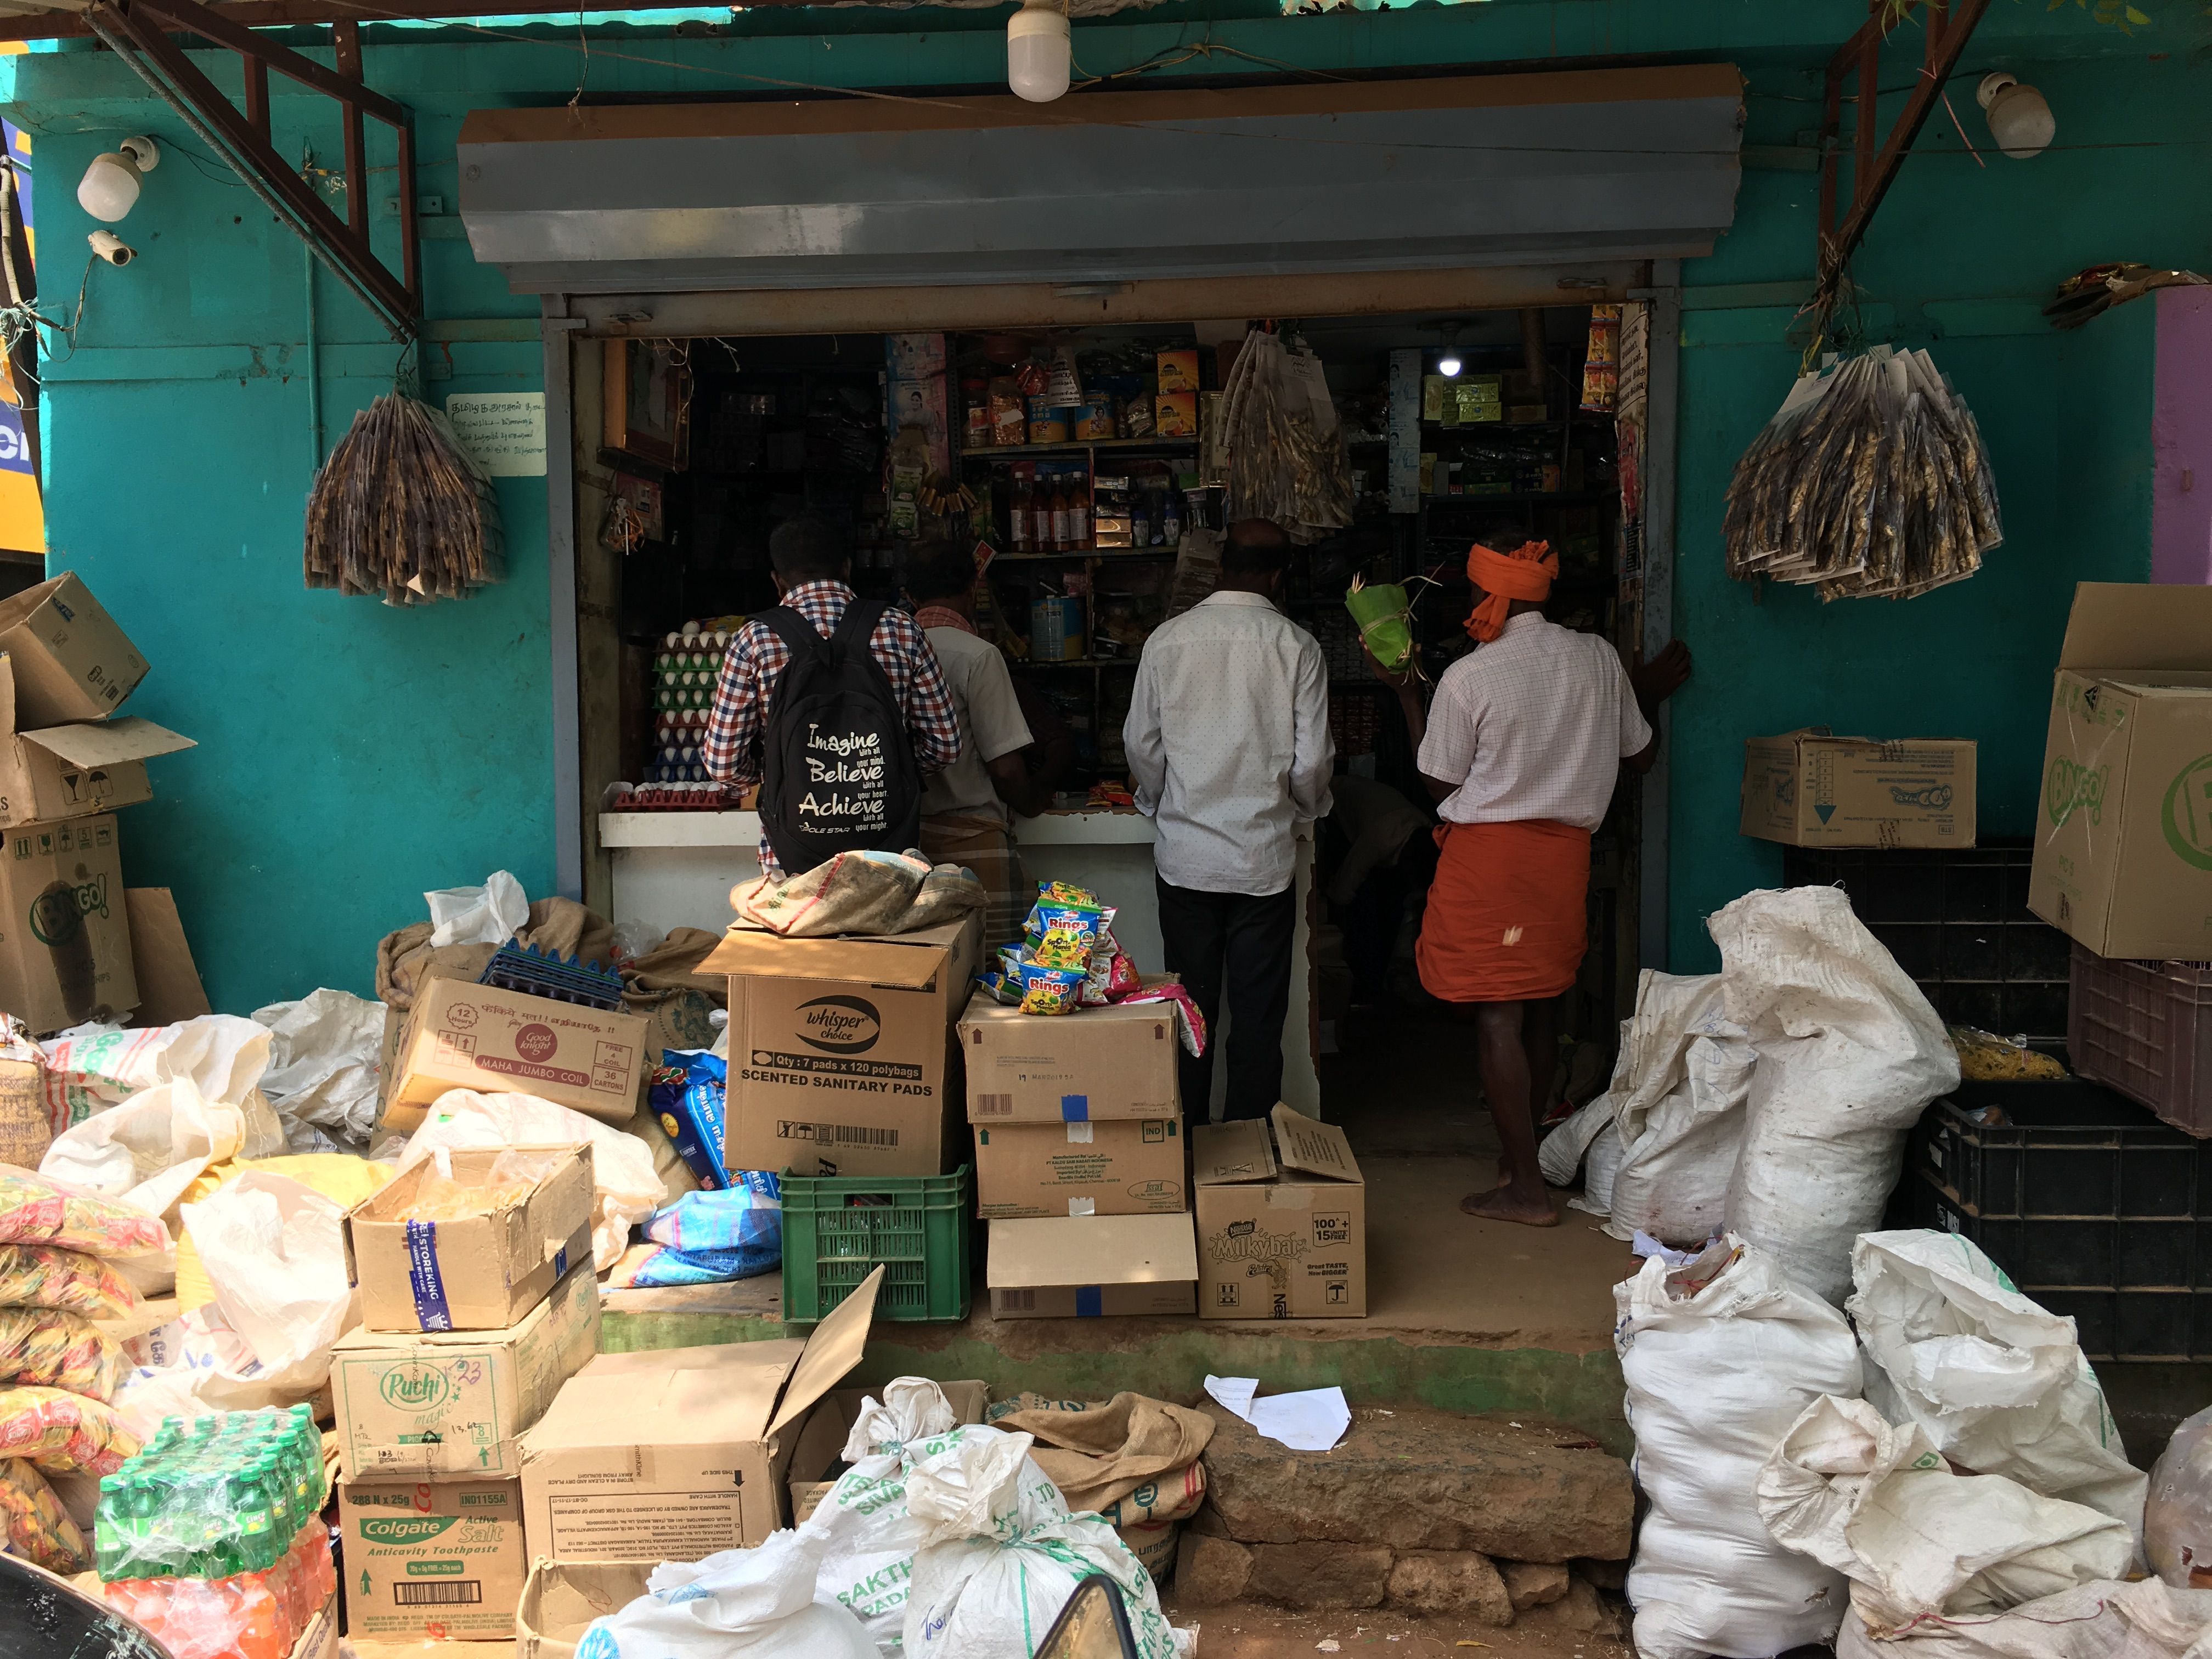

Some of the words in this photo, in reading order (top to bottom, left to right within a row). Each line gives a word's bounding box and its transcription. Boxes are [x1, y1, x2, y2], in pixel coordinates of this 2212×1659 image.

[808, 724, 879, 756] Imagine
[859, 748, 871, 757] With
[857, 759, 868, 768] your
[871, 755, 885, 765] mind.
[806, 757, 884, 783] Believe
[799, 792, 884, 816] Achieve
[871, 822, 888, 831] might.
[81, 830, 87, 839] 5
[1048, 917, 1088, 931] Rings
[1029, 977, 1070, 994] Rings
[457, 1008, 470, 1018] 12
[806, 1008, 865, 1032] whisper
[526, 1032, 551, 1041] Good
[820, 1029, 854, 1041] choice
[520, 1040, 551, 1056] knight
[605, 1044, 623, 1053] FREE
[481, 1059, 512, 1071] MAHA
[518, 1065, 555, 1079] JUMBO
[561, 1073, 583, 1084] COIL
[776, 1054, 794, 1068] Qty
[803, 1057, 810, 1068] 7
[812, 1058, 838, 1071] pads
[850, 1062, 869, 1073] 120
[871, 1063, 919, 1078] polybags
[605, 1071, 616, 1079] 36
[594, 1079, 624, 1090] CARTONS
[742, 1069, 808, 1086] SCENTED
[813, 1076, 888, 1093] SANITARY
[893, 1083, 933, 1097] PADS
[1146, 1127, 1161, 1136] IND
[1316, 1231, 1330, 1240] 15
[1214, 1235, 1305, 1260] Milkybar
[413, 1245, 421, 1266] HANDLE
[419, 1238, 439, 1300] STOREKING
[390, 1373, 440, 1402] Ruchi
[352, 1496, 370, 1505] 288
[373, 1495, 380, 1505] N
[391, 1494, 410, 1506] 25g
[465, 1515, 499, 1525] Active
[365, 1521, 440, 1538] Colgate
[458, 1524, 504, 1543] Salt
[366, 1546, 428, 1558] Anticavity
[432, 1545, 499, 1556] Toothpaste
